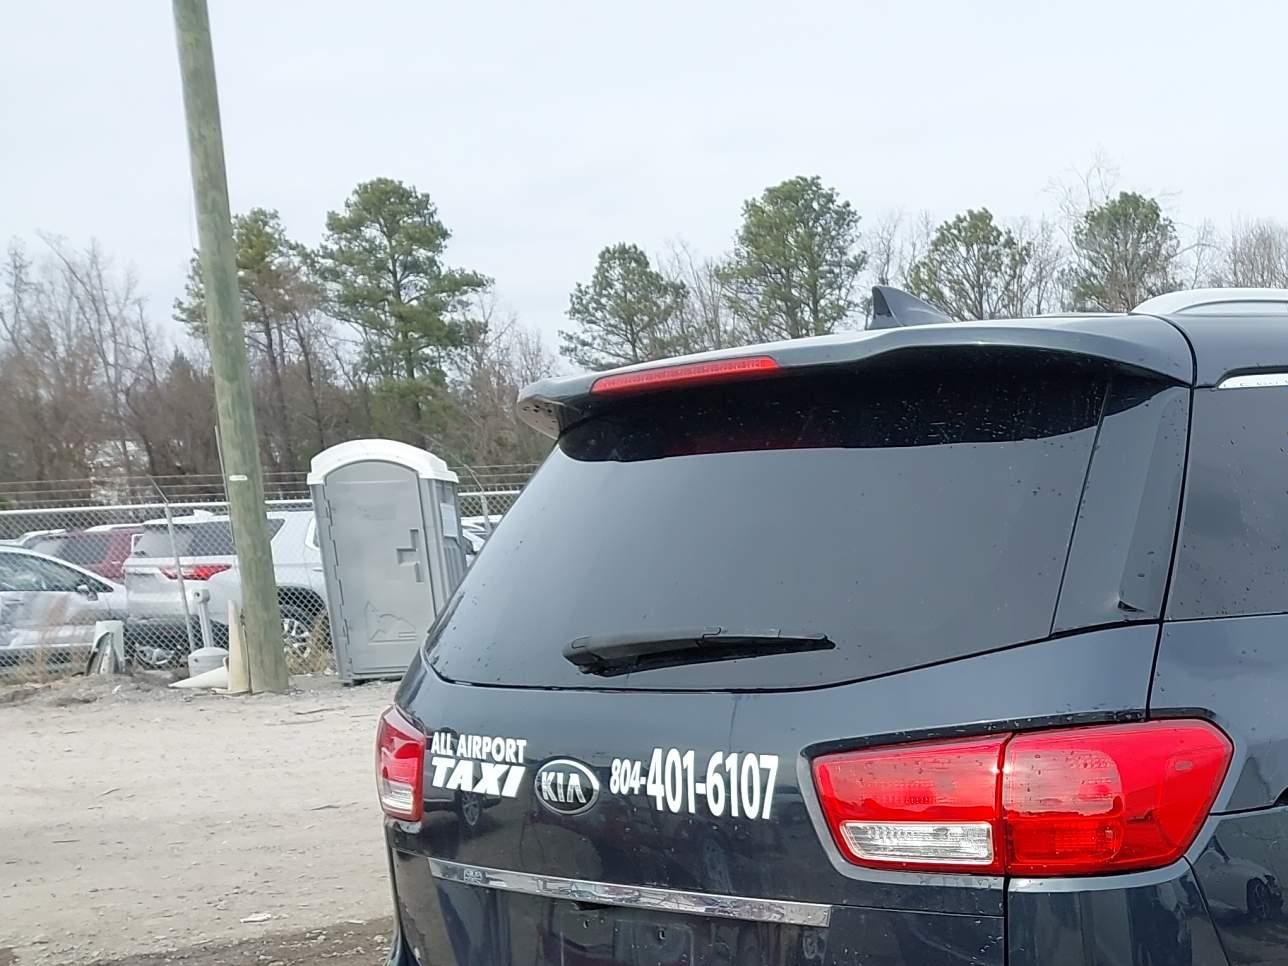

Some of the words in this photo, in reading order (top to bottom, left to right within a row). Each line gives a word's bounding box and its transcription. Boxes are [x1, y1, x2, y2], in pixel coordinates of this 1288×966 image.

[430, 731, 454, 757] ALL
[456, 733, 527, 764] AIRPORT
[431, 756, 527, 798] TAXI
[540, 771, 587, 804] KIA
[609, 747, 779, 820] 804-401-6107
